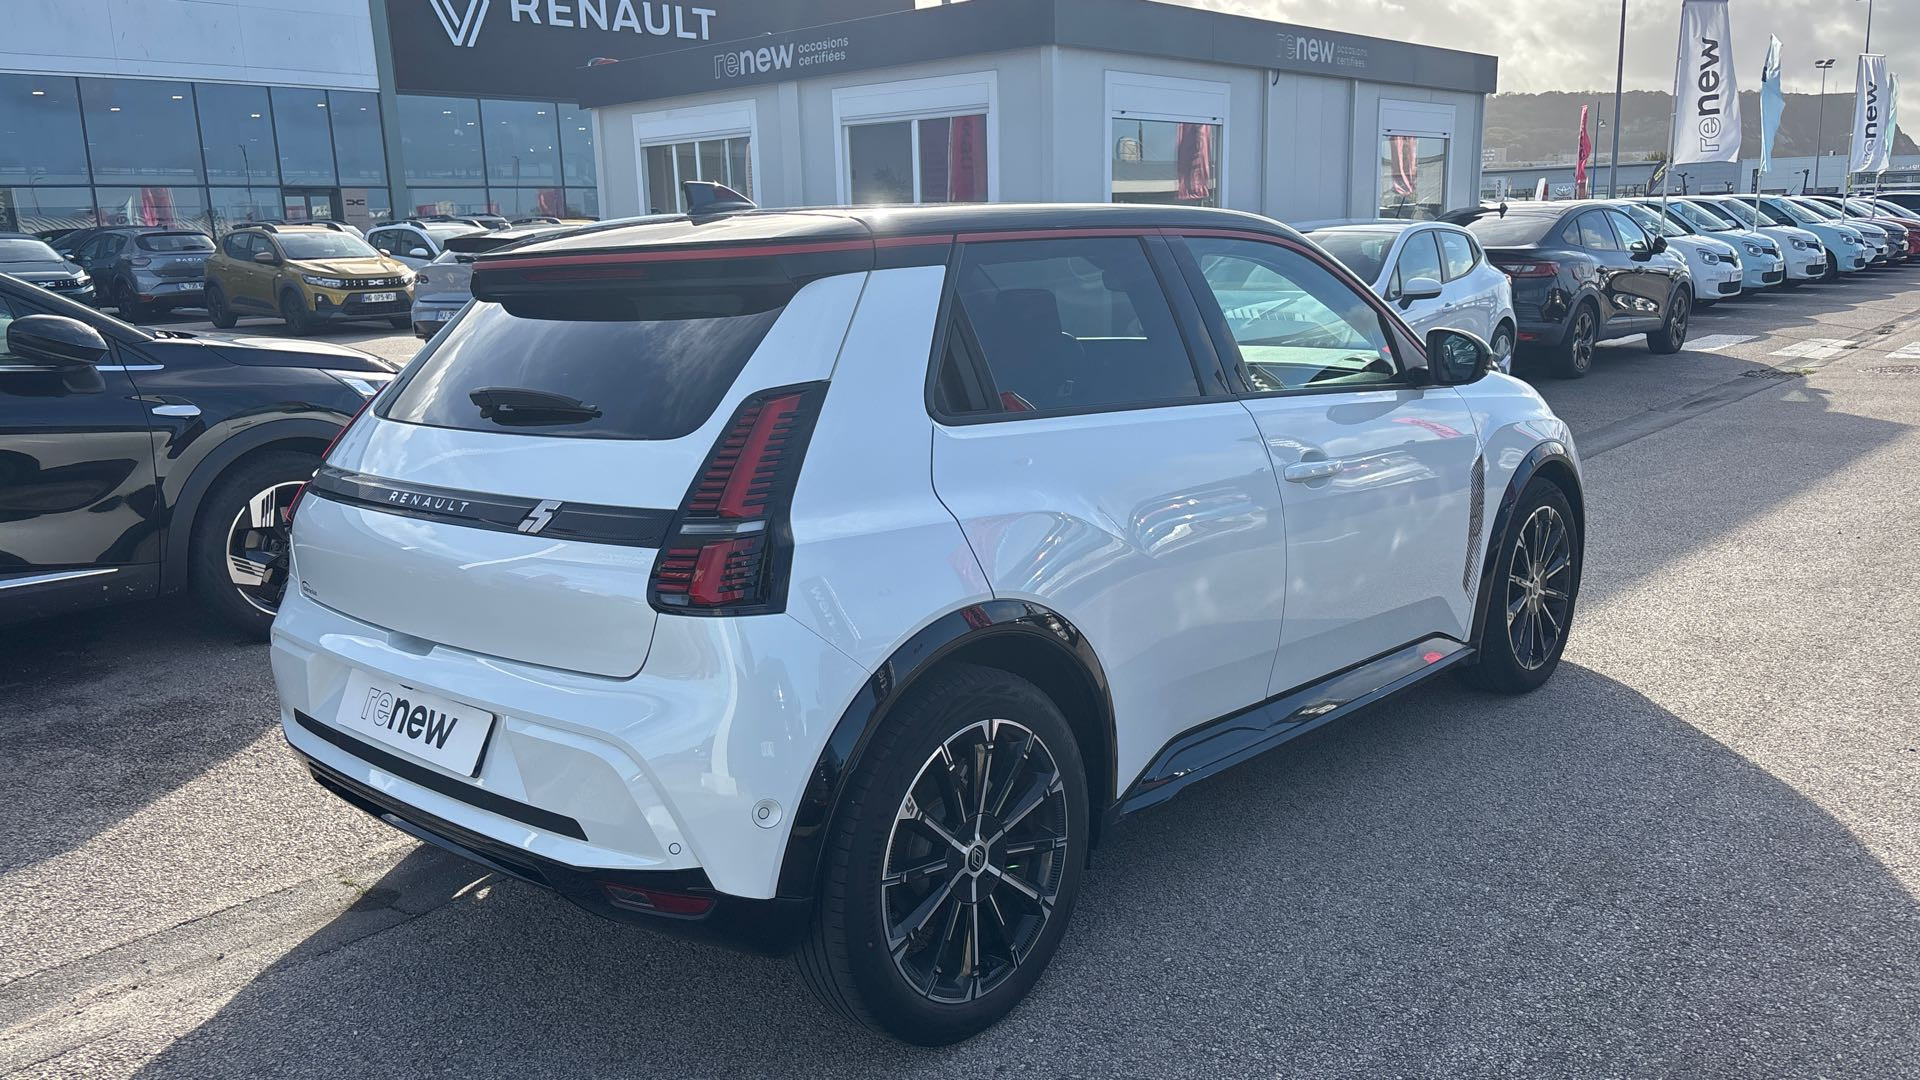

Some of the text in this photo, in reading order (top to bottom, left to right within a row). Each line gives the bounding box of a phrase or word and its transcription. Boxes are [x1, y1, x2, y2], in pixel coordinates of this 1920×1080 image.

[510, 0, 716, 40] RENAULT
[714, 43, 794, 79] renew
[798, 37, 849, 53] occasions
[798, 50, 846, 66] certifiées
[1276, 33, 1335, 64] renew
[1698, 37, 1721, 152] renew
[388, 491, 470, 513] RENAULT
[360, 686, 459, 750] renew
